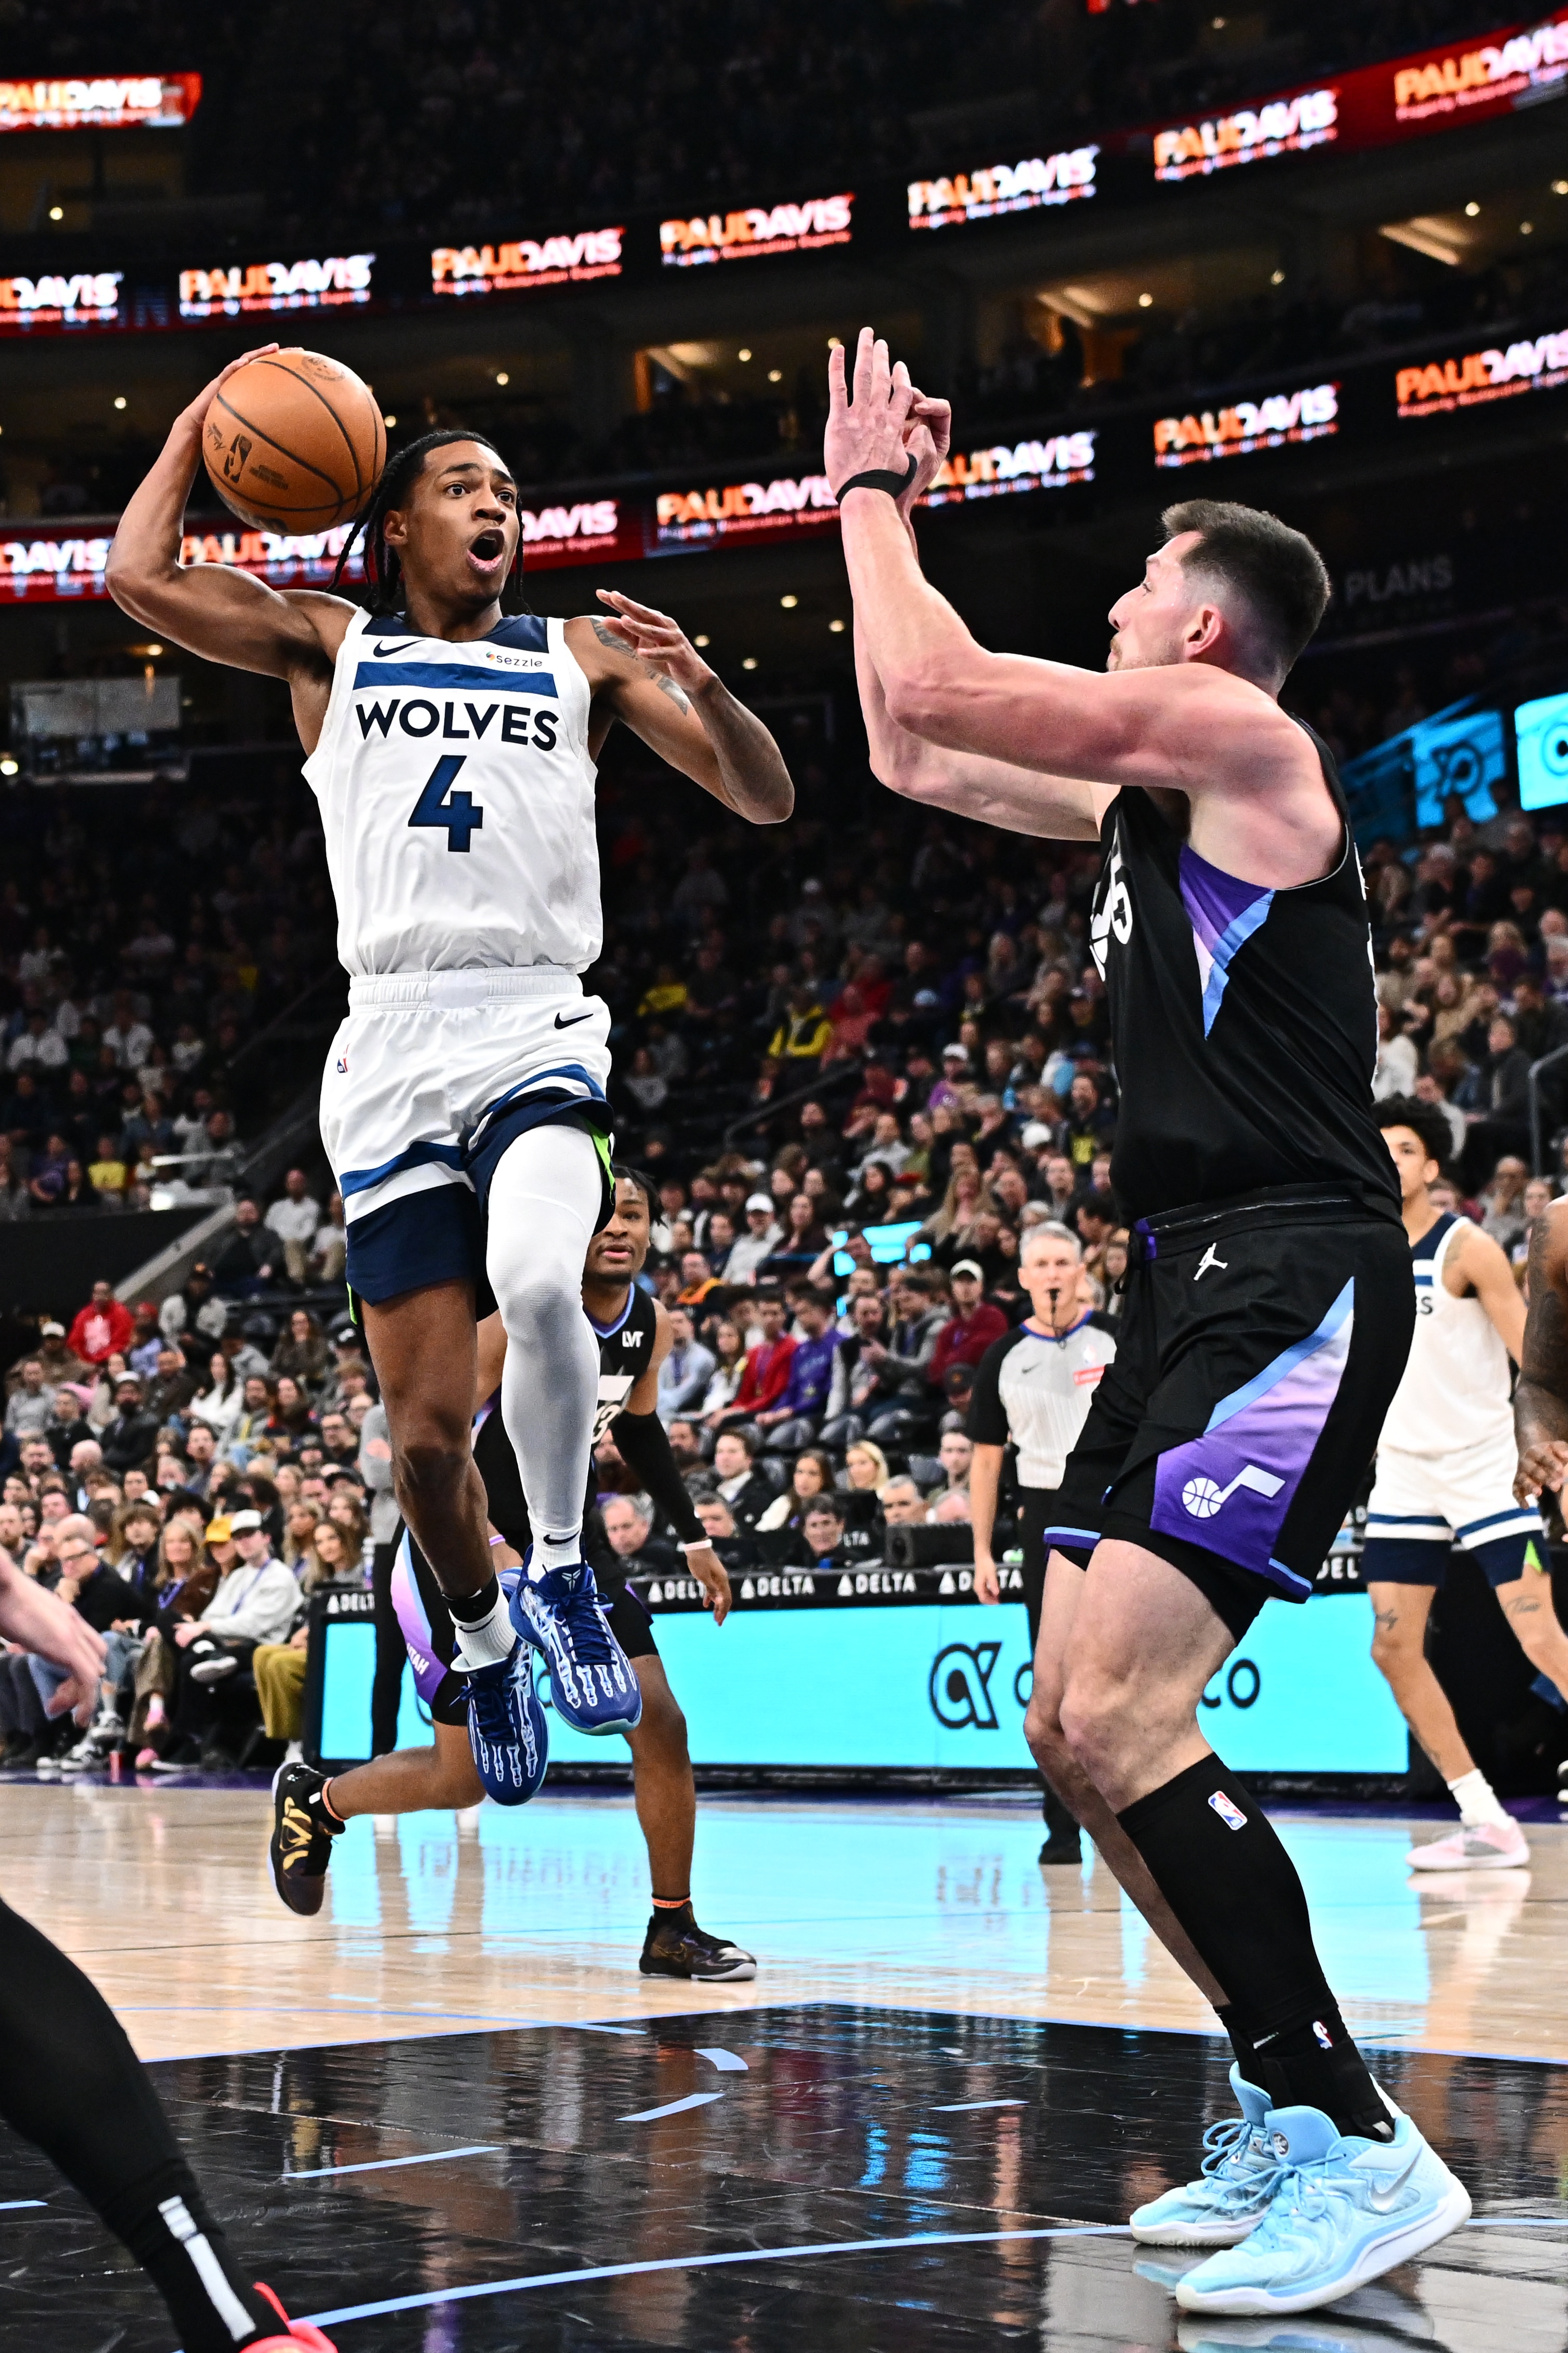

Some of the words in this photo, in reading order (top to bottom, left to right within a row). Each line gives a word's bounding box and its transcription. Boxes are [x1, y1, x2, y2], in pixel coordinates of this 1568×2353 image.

[496, 654, 543, 667] sezzle
[356, 699, 559, 752] WOLVES
[408, 755, 484, 853] 4
[836, 1531, 871, 1547] LTA
[757, 1576, 816, 1597] DELTA
[855, 1573, 917, 1594] DELTA
[958, 1569, 1024, 1592] DTA
